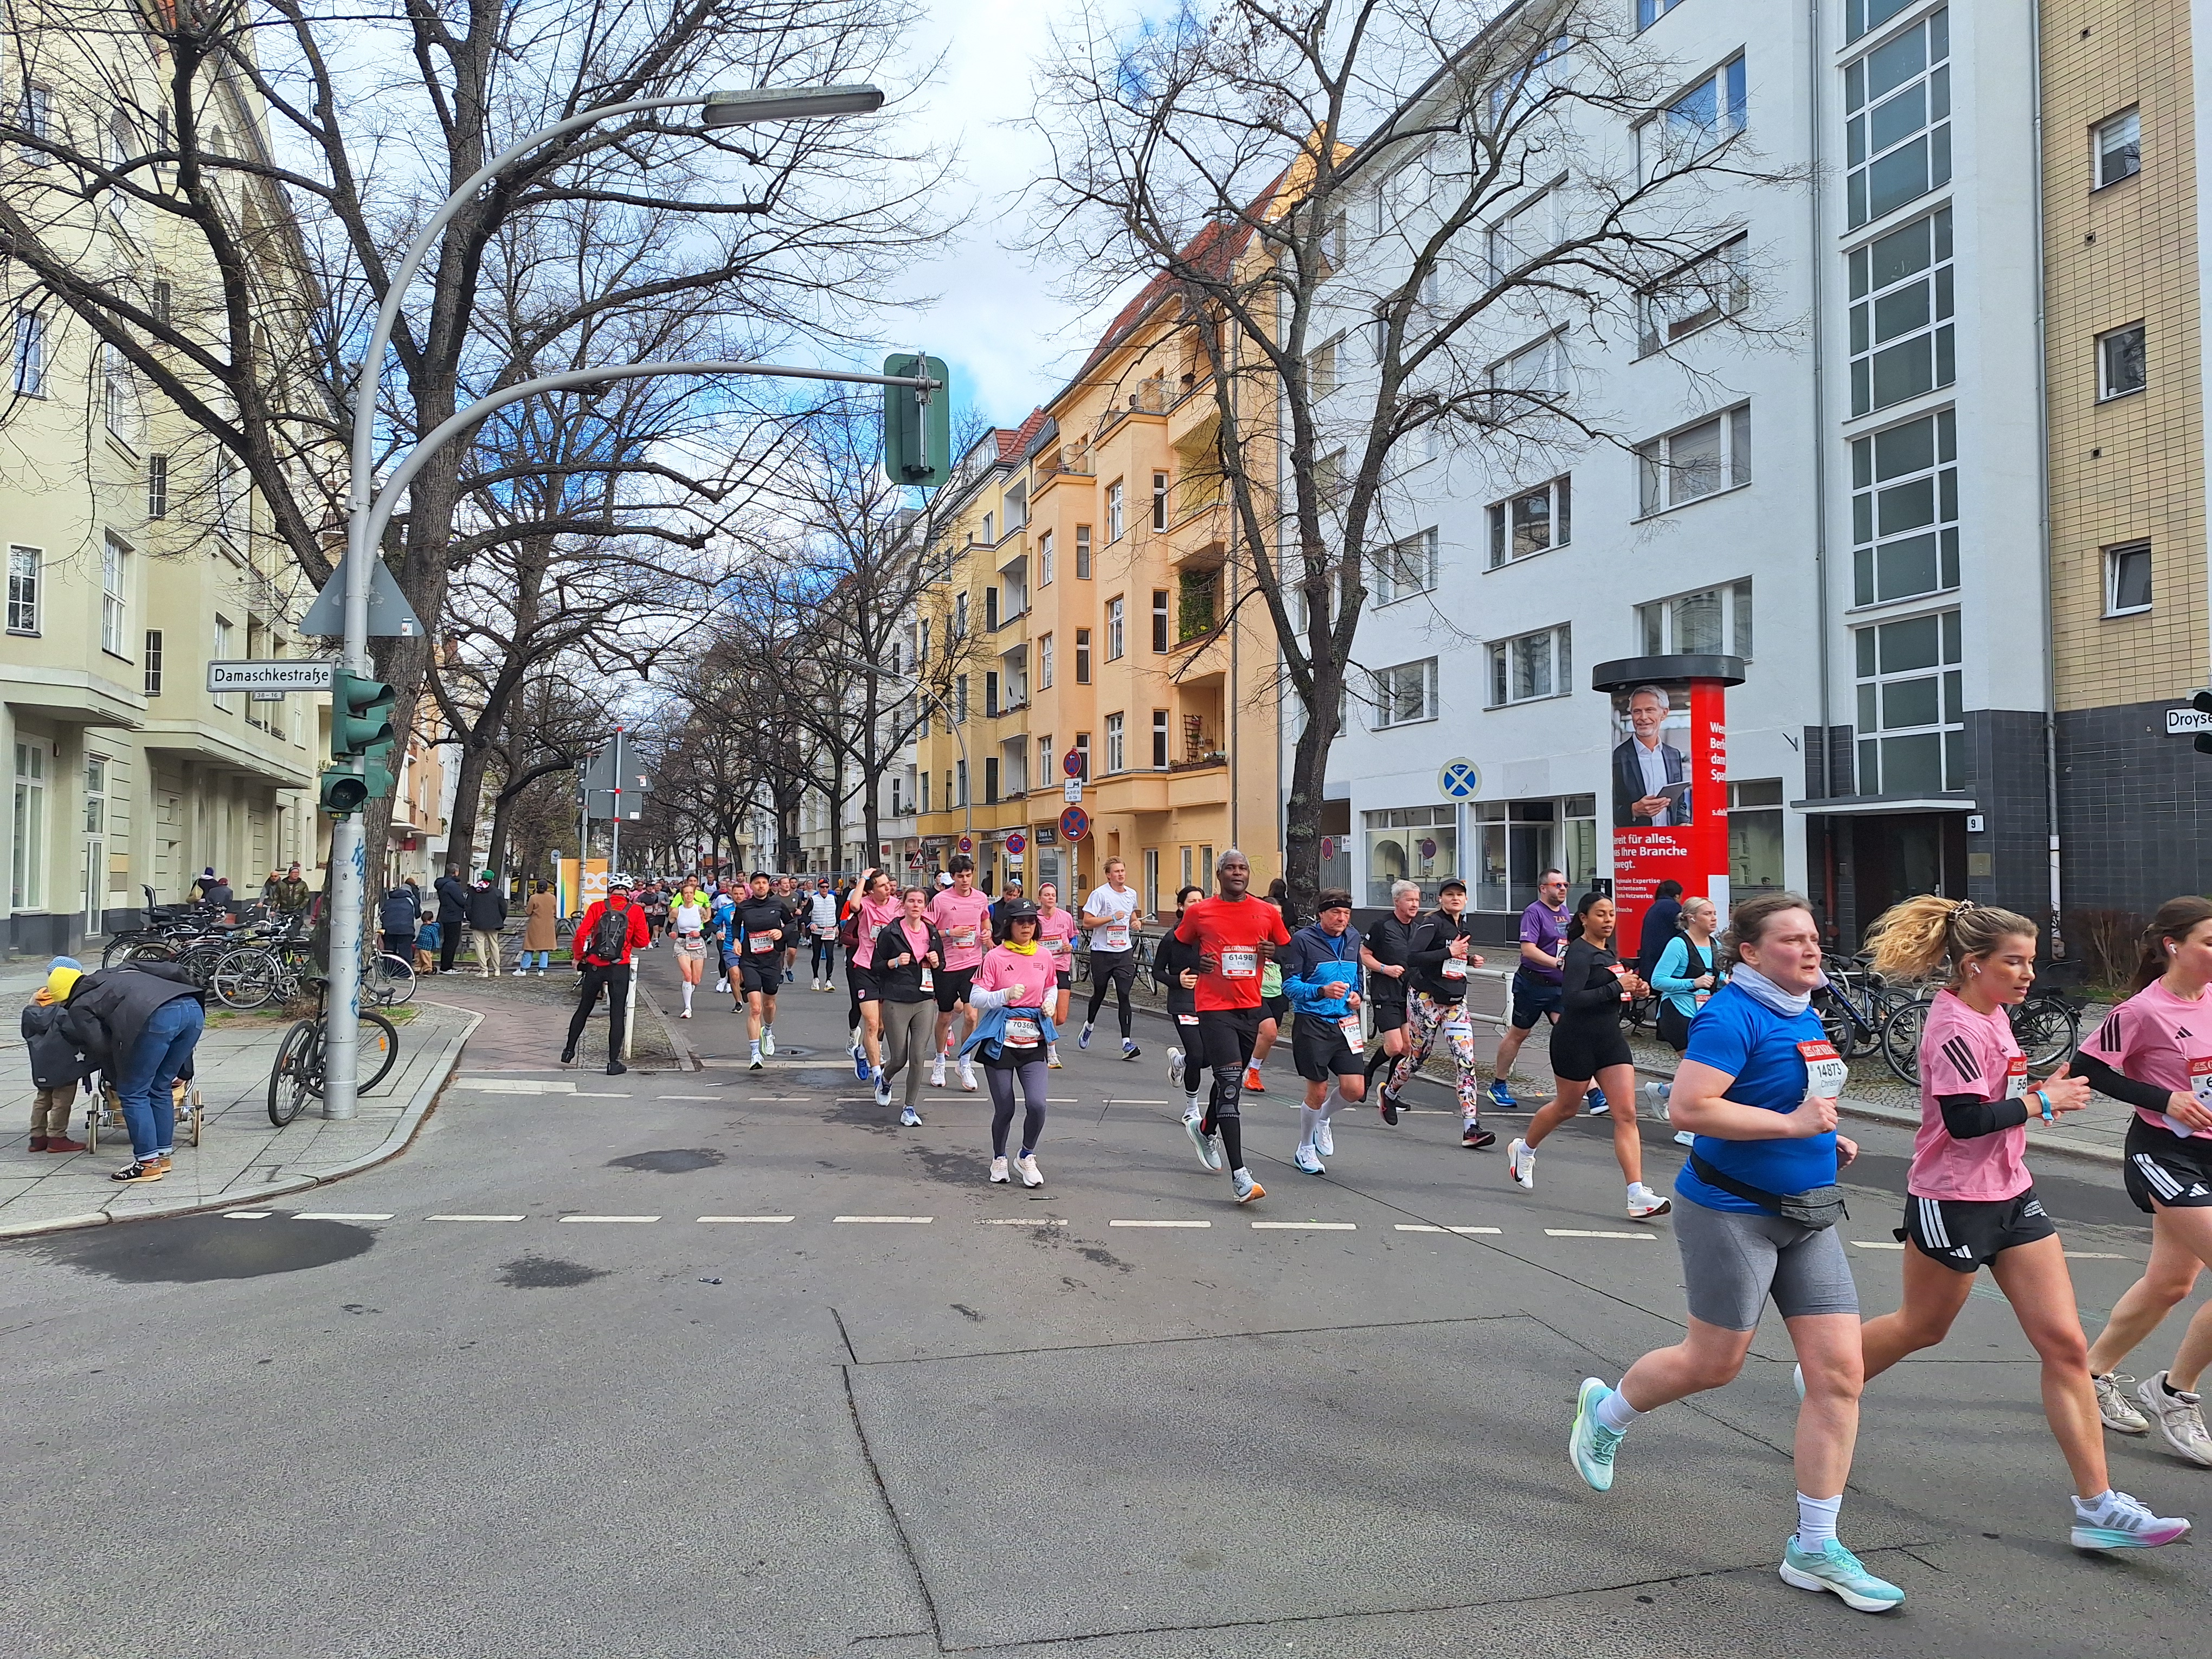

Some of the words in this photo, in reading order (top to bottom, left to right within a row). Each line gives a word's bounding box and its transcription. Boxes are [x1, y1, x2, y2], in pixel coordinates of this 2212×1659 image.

[215, 667, 329, 684] Damaschkestraße
[1971, 819, 1976, 828] 9
[1628, 833, 1643, 844] für
[1645, 833, 1676, 844] alles,
[1639, 845, 1688, 856] Branche
[1817, 1063, 1842, 1078] 14873
